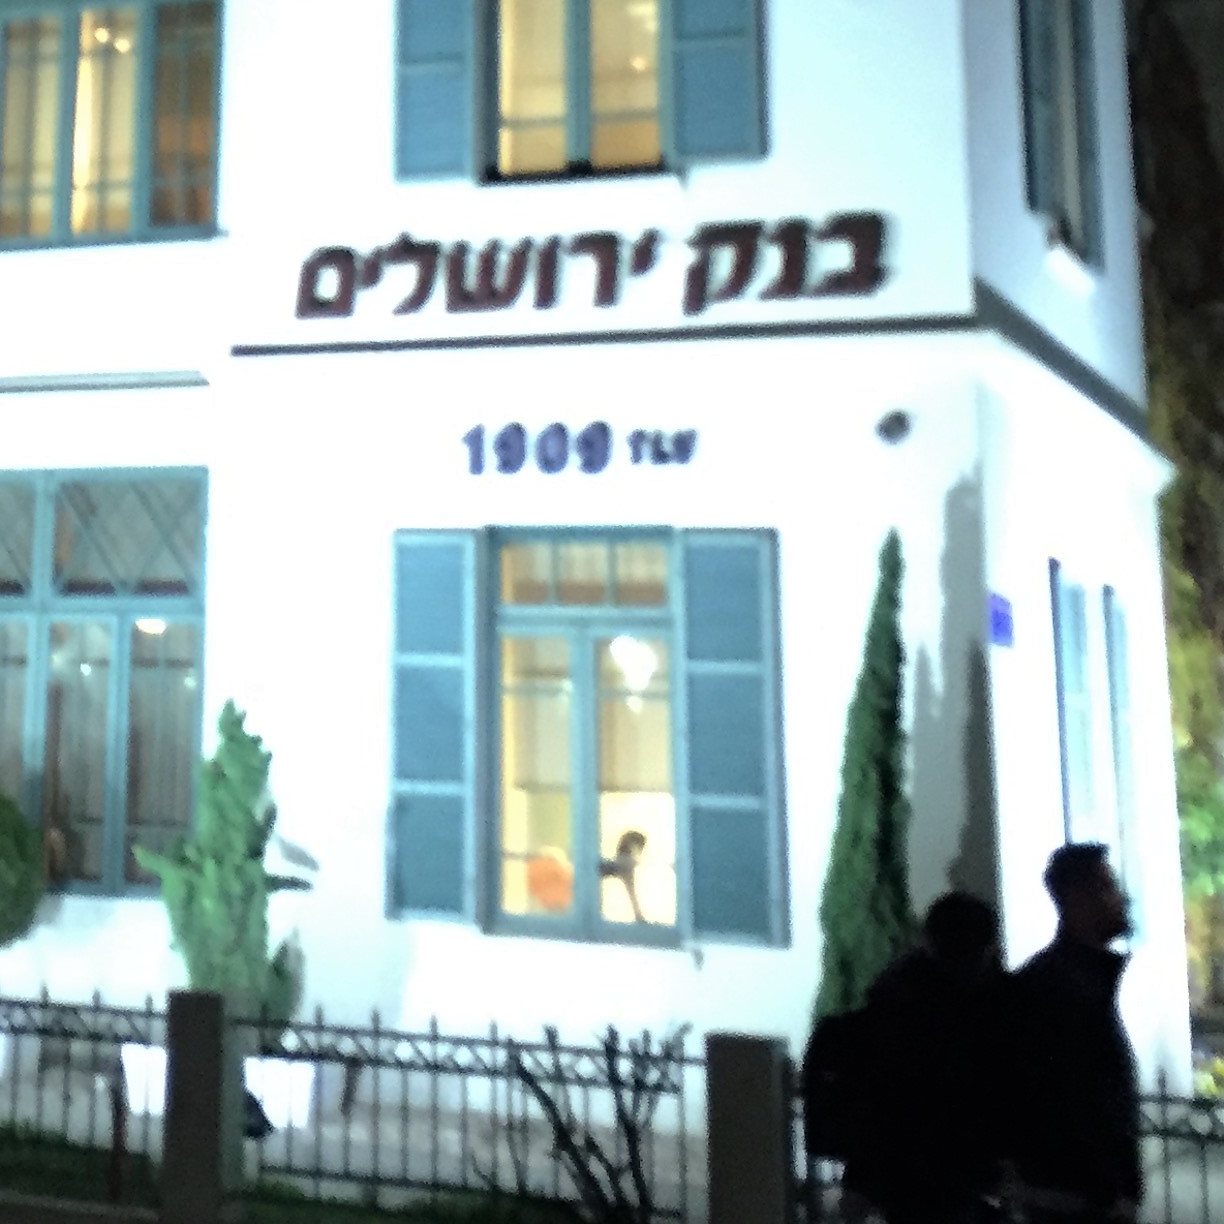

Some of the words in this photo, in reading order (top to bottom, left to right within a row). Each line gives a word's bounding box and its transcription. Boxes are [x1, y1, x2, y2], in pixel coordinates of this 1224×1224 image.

[296, 229, 664, 319] ירושלים
[684, 210, 890, 316] בנק
[464, 421, 612, 474] 1909
